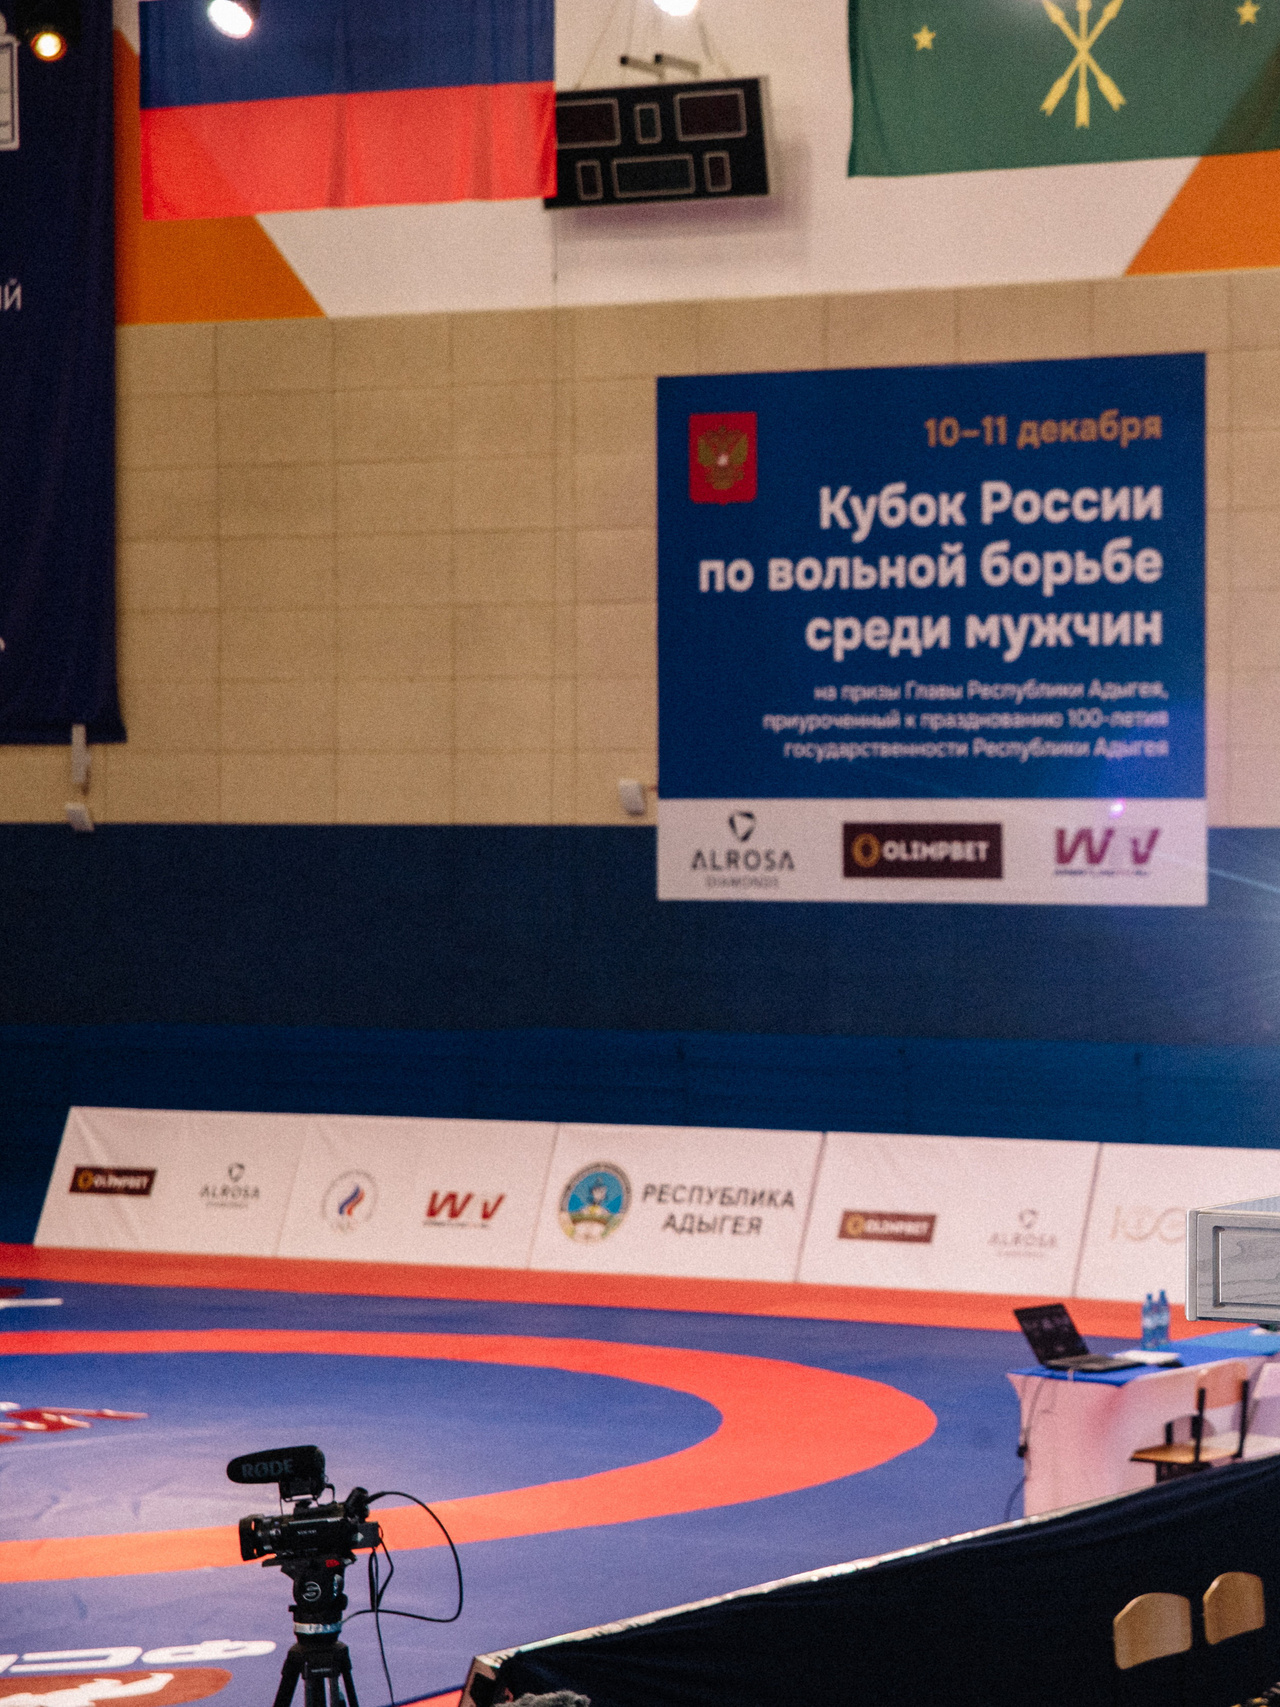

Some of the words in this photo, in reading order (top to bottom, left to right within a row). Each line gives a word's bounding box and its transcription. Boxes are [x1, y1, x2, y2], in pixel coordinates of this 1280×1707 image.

[1017, 409, 1162, 449] декабря
[820, 482, 966, 543] Кубок
[981, 481, 1163, 525] России
[700, 559, 754, 592] по
[768, 542, 966, 591] вольной
[980, 536, 1163, 597] борьбе
[805, 613, 951, 662] среди
[965, 611, 1163, 662] мужчин
[814, 685, 837, 700] на
[841, 684, 900, 704] призы
[905, 680, 963, 701] Главы
[967, 679, 1084, 704] Республики
[763, 709, 900, 734] приуроченный
[905, 714, 916, 729] к
[920, 712, 1064, 733] празднованию
[784, 742, 968, 763] государственности
[972, 737, 1090, 763] Республики
[691, 850, 795, 871] ALROSA
[643, 1184, 795, 1208] РЕСПУБЛИКА
[662, 1213, 763, 1235] АДЫГЕЯ
